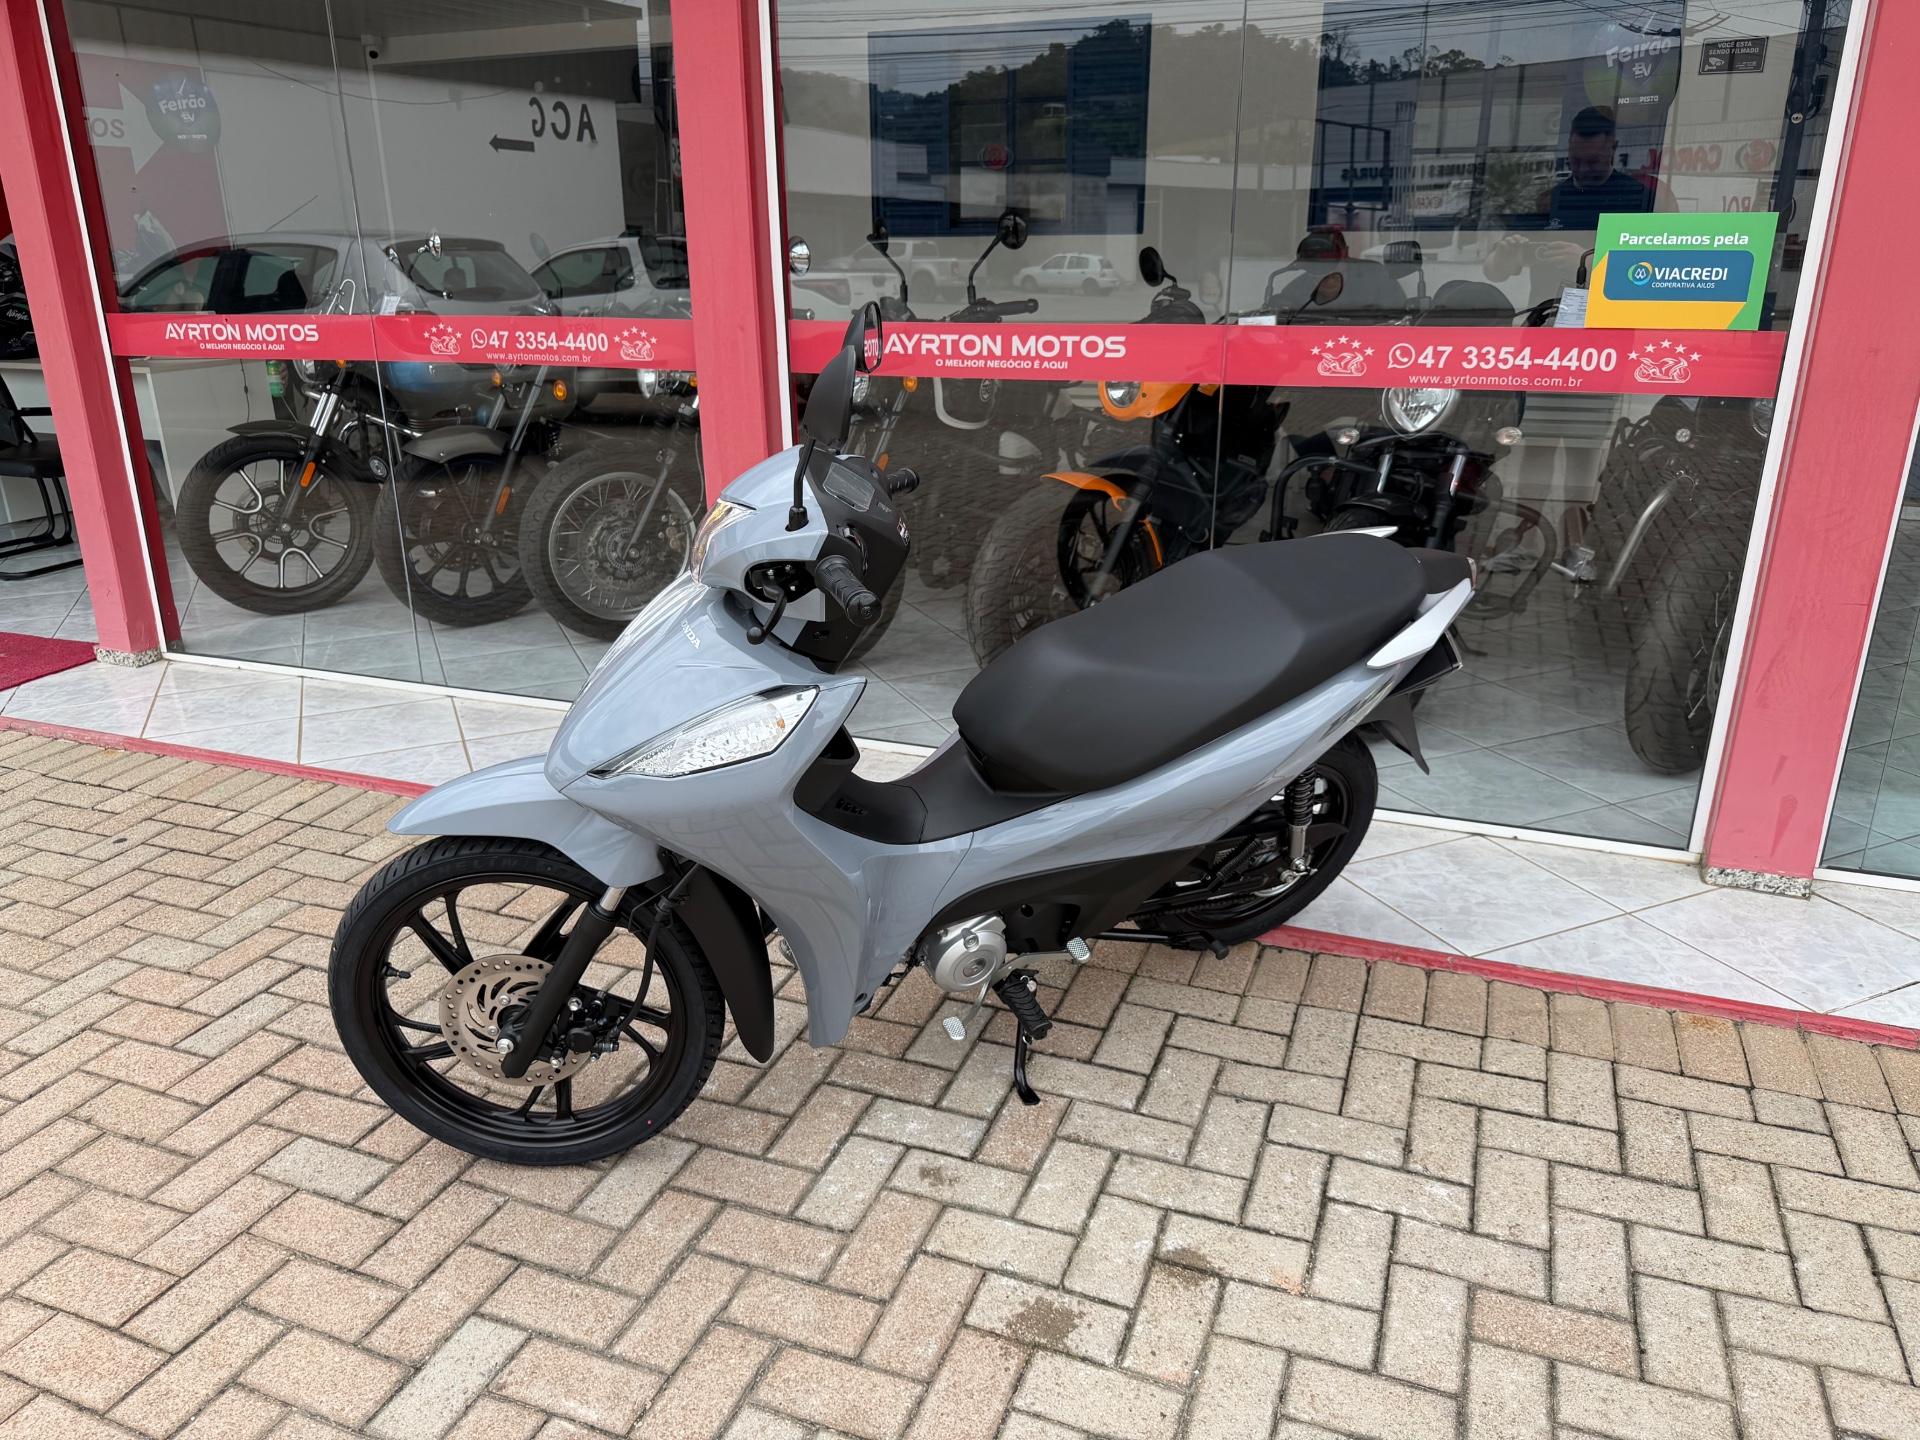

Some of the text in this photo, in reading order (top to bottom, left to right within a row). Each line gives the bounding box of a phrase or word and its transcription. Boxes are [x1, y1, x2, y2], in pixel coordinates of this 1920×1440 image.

[158, 94, 206, 115] Feirão
[1619, 232, 1749, 247] Parcelamos pela
[1654, 267, 1728, 280] VIACREDI
[166, 323, 319, 342] AYRTON MOTOS
[206, 342, 232, 350] MELHOR
[233, 342, 261, 350] NEGÓCIO
[268, 343, 285, 351] AQUI
[489, 330, 609, 352] 47 3354-4400
[884, 333, 1127, 359] AYRTON MOTOS
[486, 352, 592, 363] www.ayrtonmotos.com.br
[935, 357, 1068, 369] O MELHOR NEGÓCIO É AQUI
[1417, 345, 1617, 372] 47 3354-4400
[1408, 374, 1584, 387] www.ayrtonmotos.com.br
